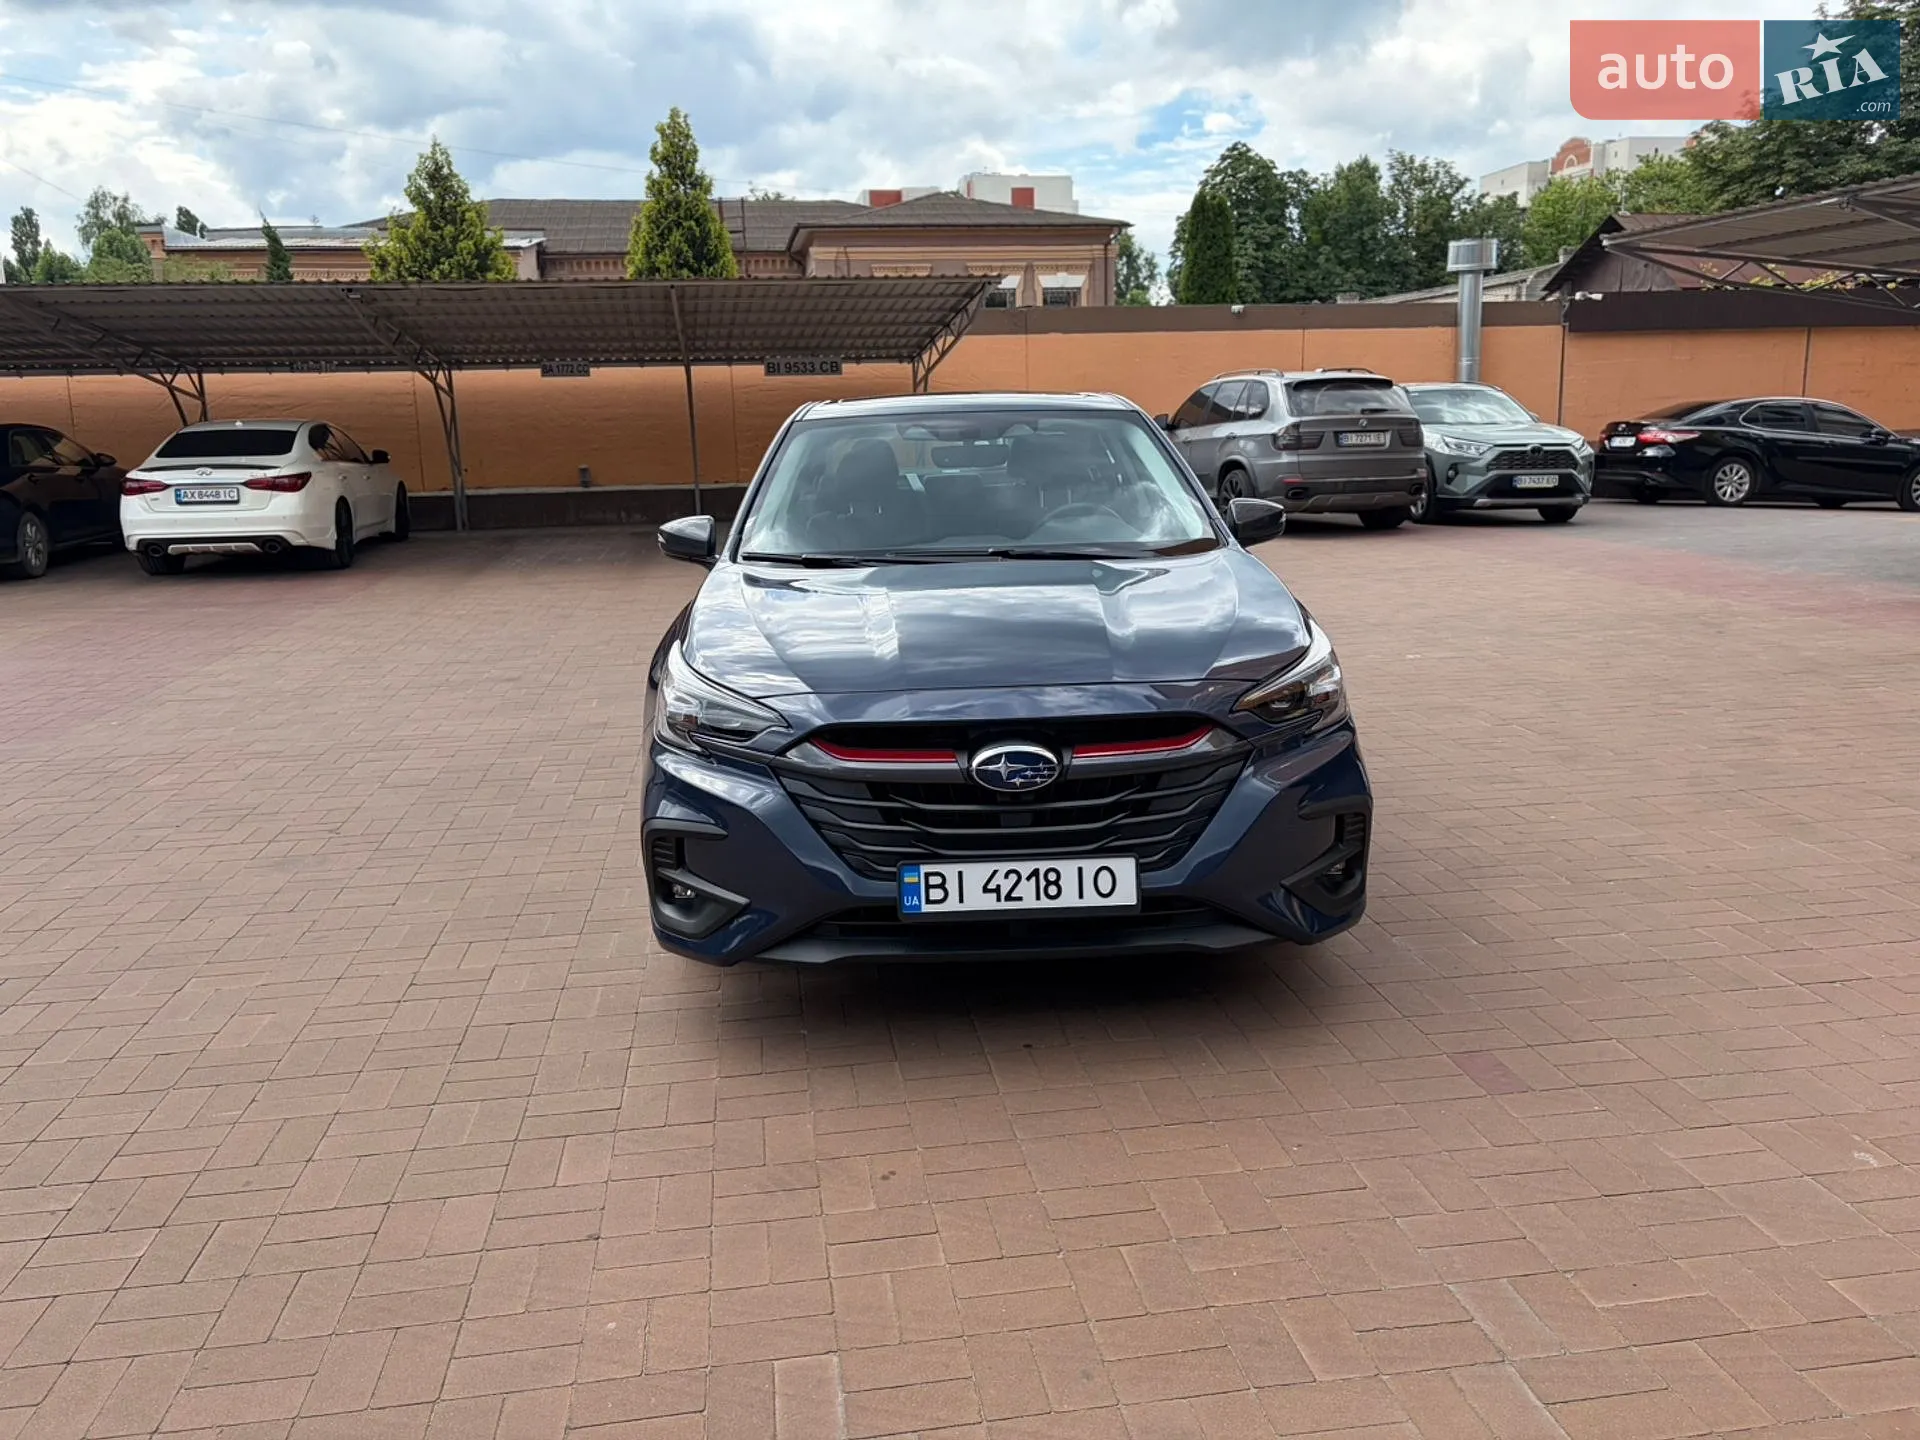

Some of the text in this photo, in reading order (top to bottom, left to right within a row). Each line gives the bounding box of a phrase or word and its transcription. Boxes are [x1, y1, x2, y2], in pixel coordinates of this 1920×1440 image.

[767, 361, 839, 373] BI 9533 CB
[198, 490, 221, 499] 8448
[924, 865, 1117, 905] BI 4218 IO
[903, 895, 920, 906] UA
